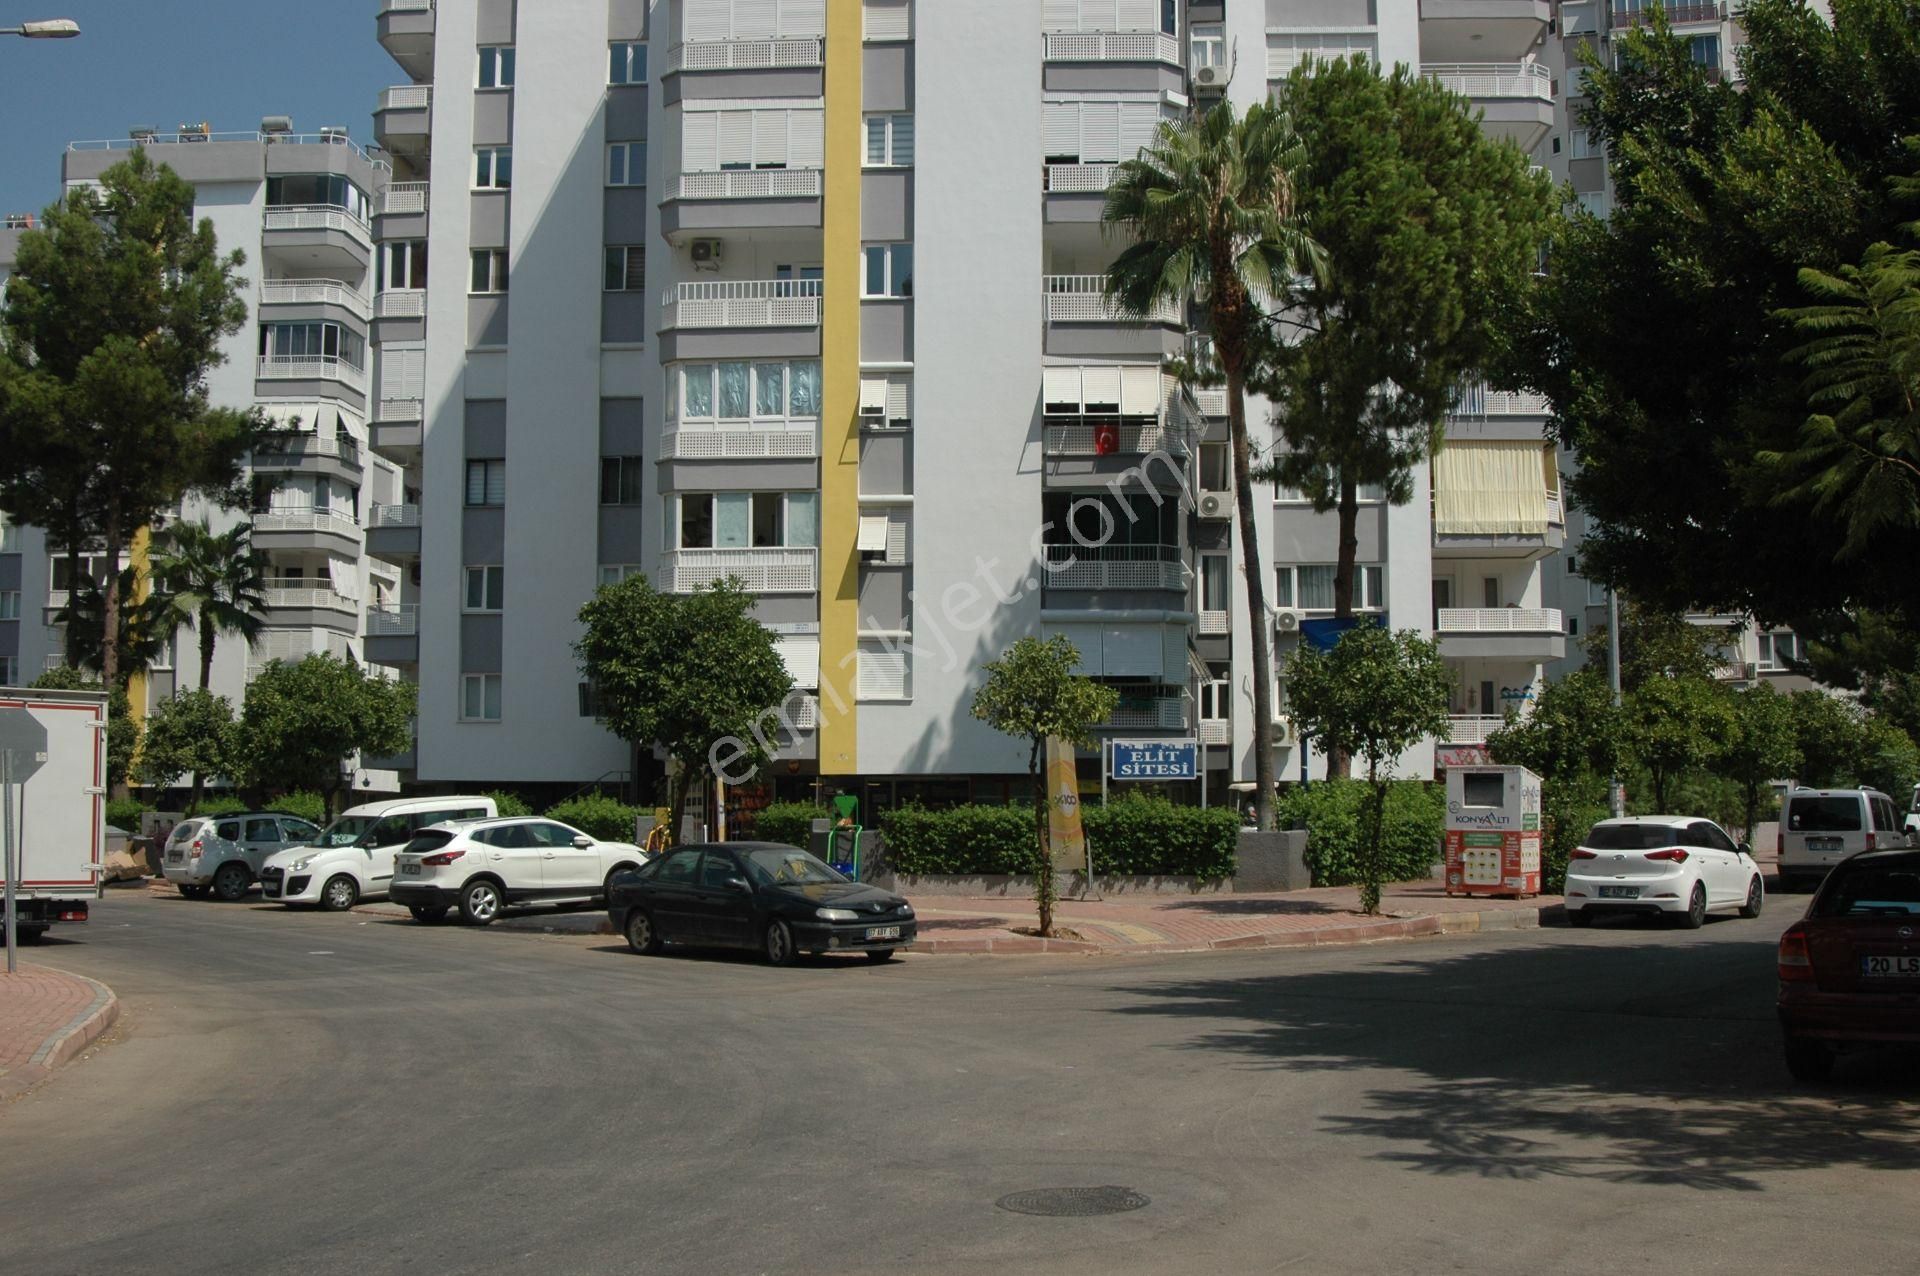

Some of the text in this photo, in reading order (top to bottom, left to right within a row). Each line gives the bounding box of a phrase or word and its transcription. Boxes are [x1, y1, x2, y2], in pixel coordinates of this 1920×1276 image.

[1130, 749, 1180, 762] ELİT
[1121, 762, 1189, 775] SİTESİ
[1870, 957, 1890, 972] 20
